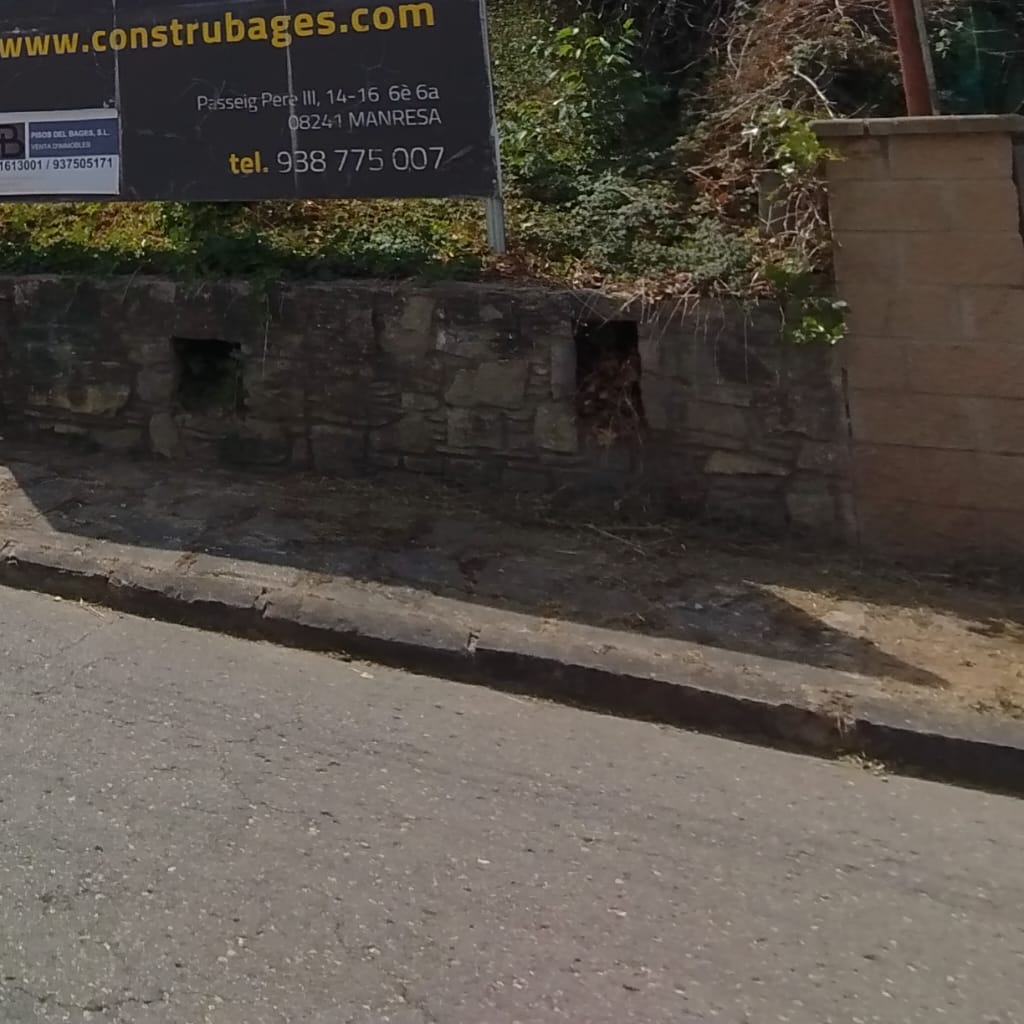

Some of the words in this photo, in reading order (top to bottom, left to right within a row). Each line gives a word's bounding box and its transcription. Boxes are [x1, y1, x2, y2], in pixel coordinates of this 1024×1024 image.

[197, 94, 258, 113] Passeig
[261, 92, 298, 107] Pere
[326, 87, 380, 104] 14-16
[388, 84, 412, 101] 6è
[416, 84, 440, 100] 6a
[288, 114, 342, 130] 08241
[348, 108, 442, 128] MANRESA
[54, 130, 67, 138] DEL
[53, 157, 113, 170] 937505171
[229, 151, 269, 174] tel.
[277, 150, 327, 173] 938
[334, 149, 384, 172] 775
[392, 147, 444, 170] 007
